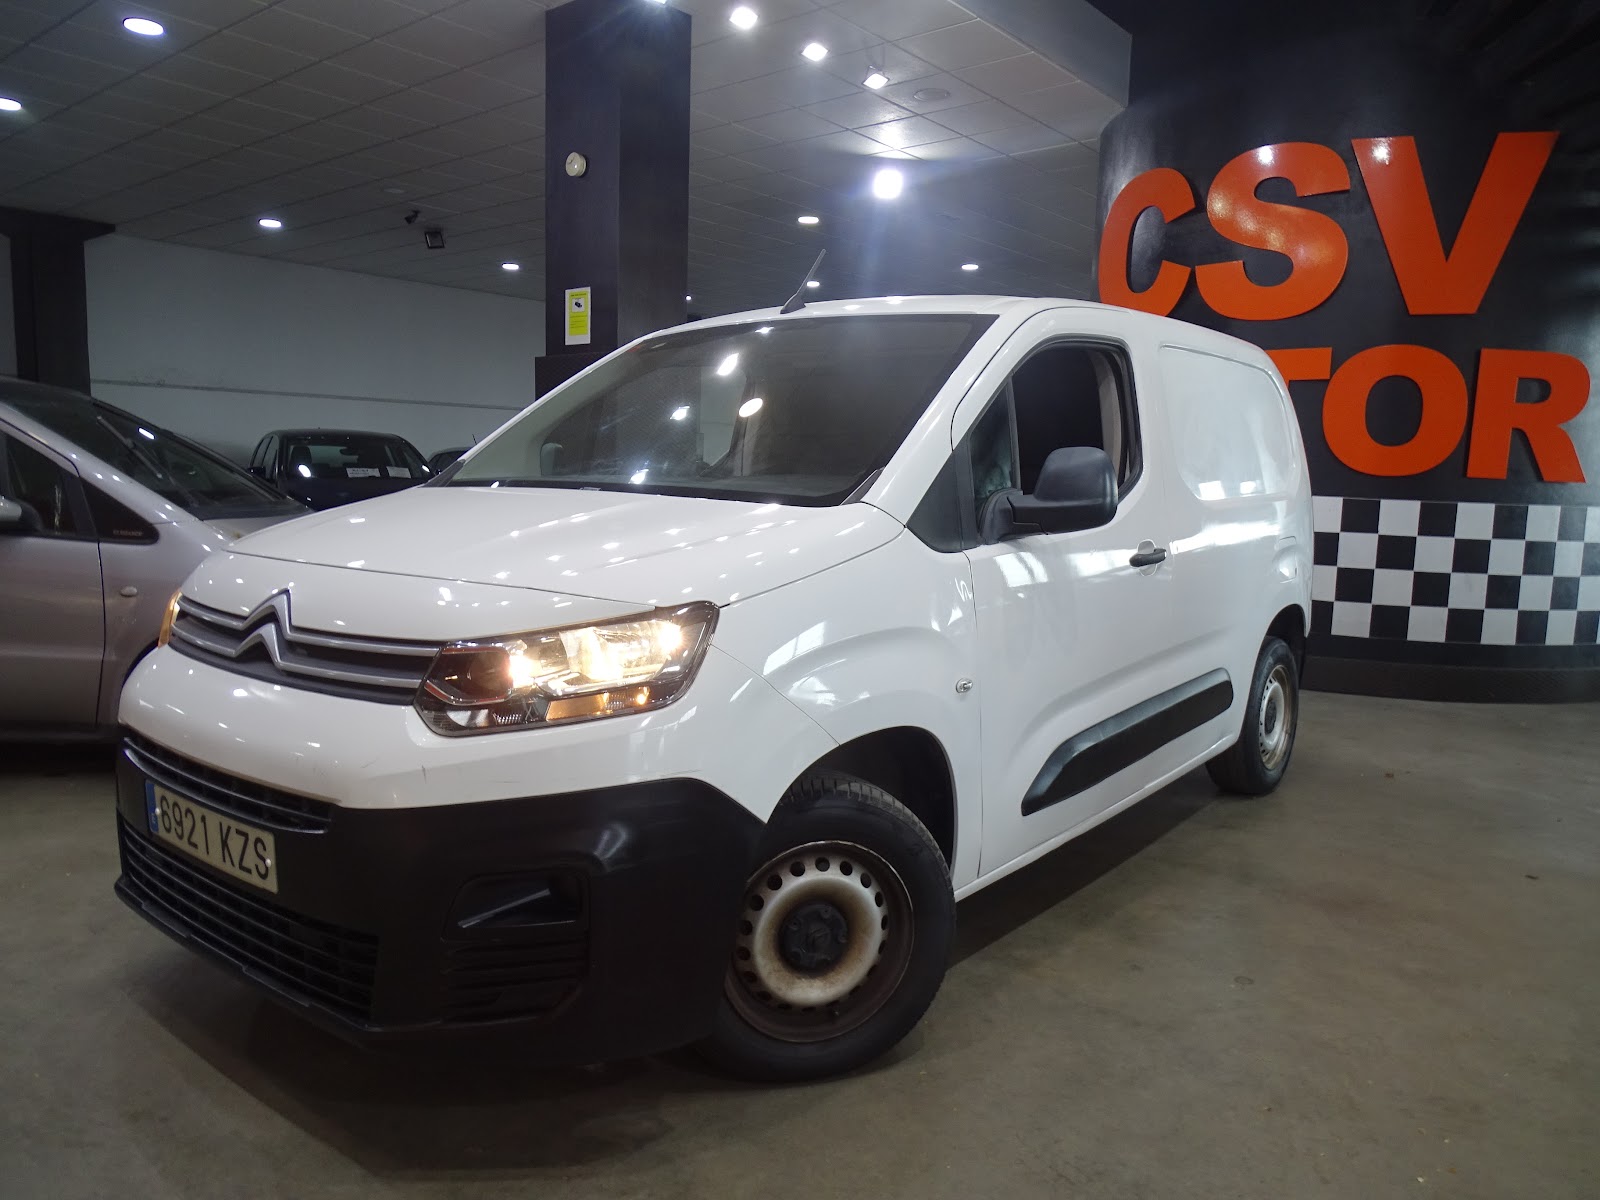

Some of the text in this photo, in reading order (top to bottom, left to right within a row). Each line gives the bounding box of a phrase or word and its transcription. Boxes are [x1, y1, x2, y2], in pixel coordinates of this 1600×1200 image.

[1099, 131, 1559, 321] CSV
[160, 795, 209, 855] 6921
[219, 821, 270, 880] KZS
